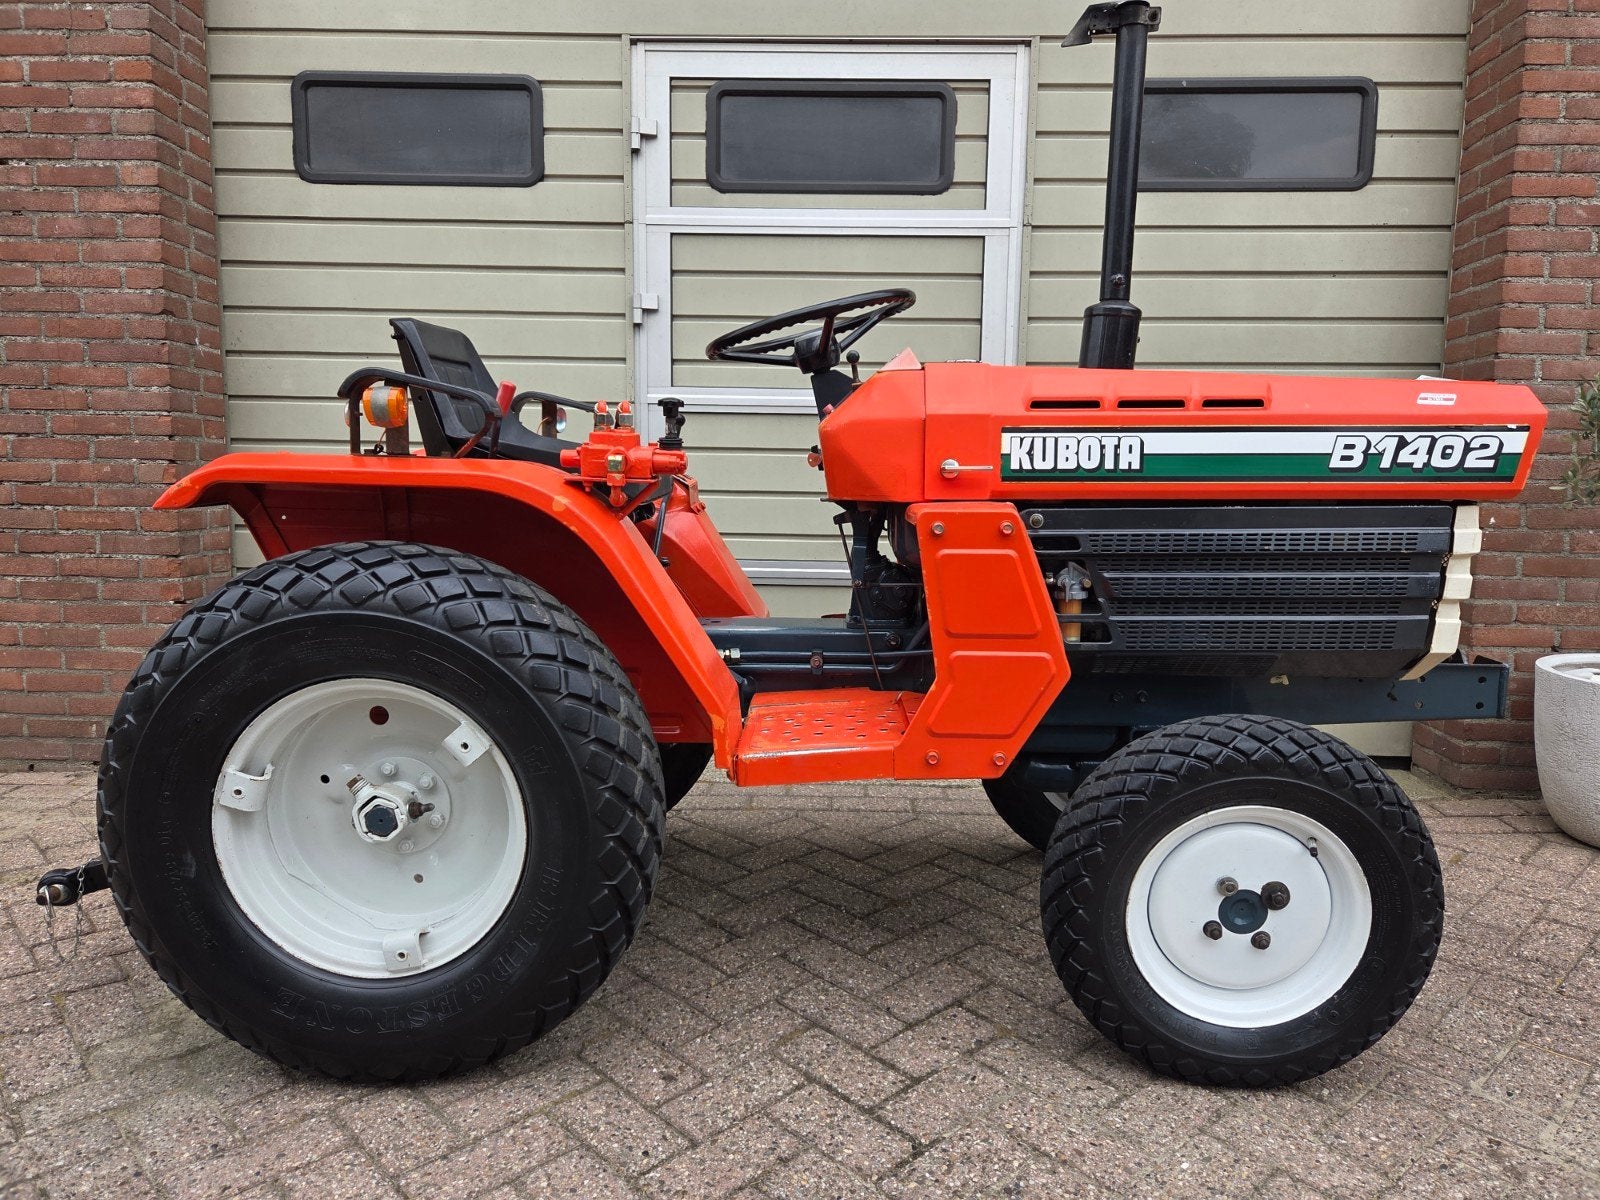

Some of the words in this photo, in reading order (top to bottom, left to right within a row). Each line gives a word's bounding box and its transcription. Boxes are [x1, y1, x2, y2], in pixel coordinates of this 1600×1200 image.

[1010, 435, 1144, 472] KUBOTA
[1328, 434, 1504, 473] B1402
[271, 862, 564, 1034] BRIDGESTONE
